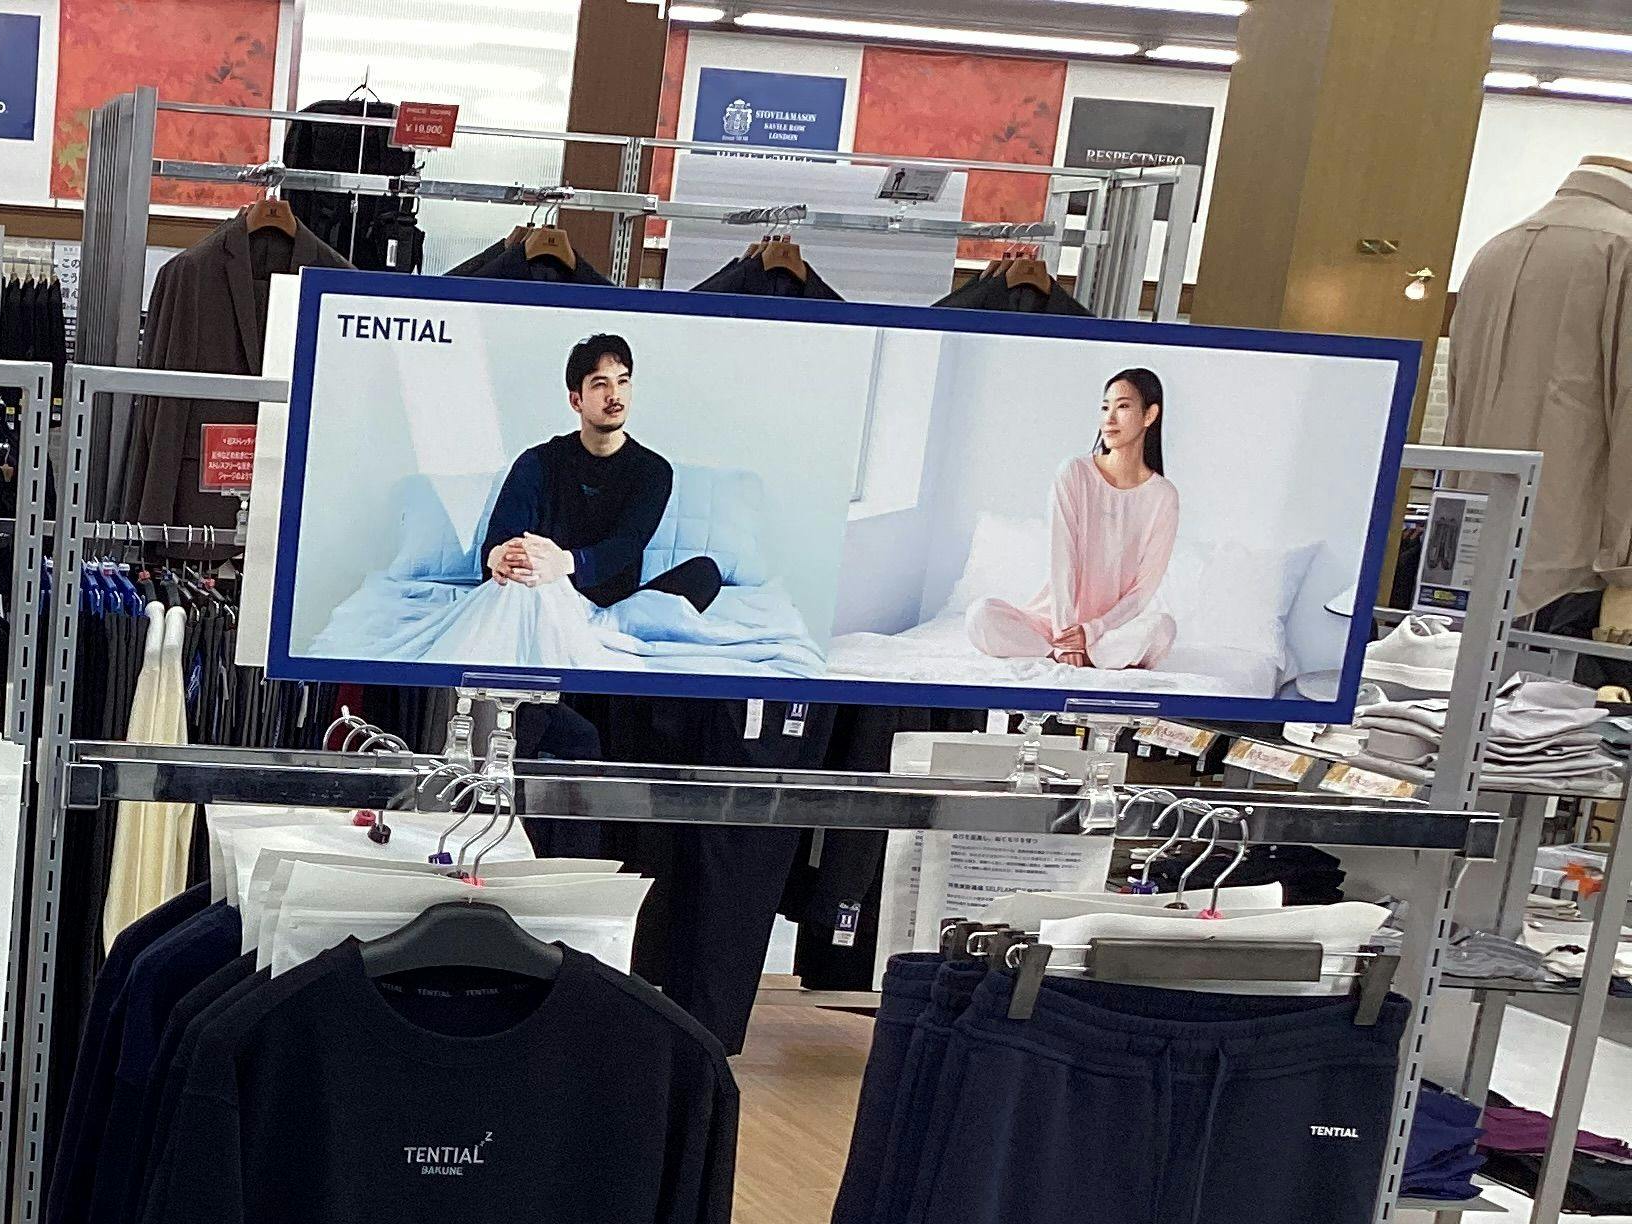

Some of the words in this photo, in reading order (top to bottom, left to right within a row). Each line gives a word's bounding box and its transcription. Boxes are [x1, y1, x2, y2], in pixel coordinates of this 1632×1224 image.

[768, 132, 799, 141] LONDON
[337, 314, 453, 344] TENTIAL
[1310, 1125, 1359, 1138] TENTIAL
[403, 1145, 485, 1164] TENTIAL
[421, 1165, 464, 1176] BAKUNE
